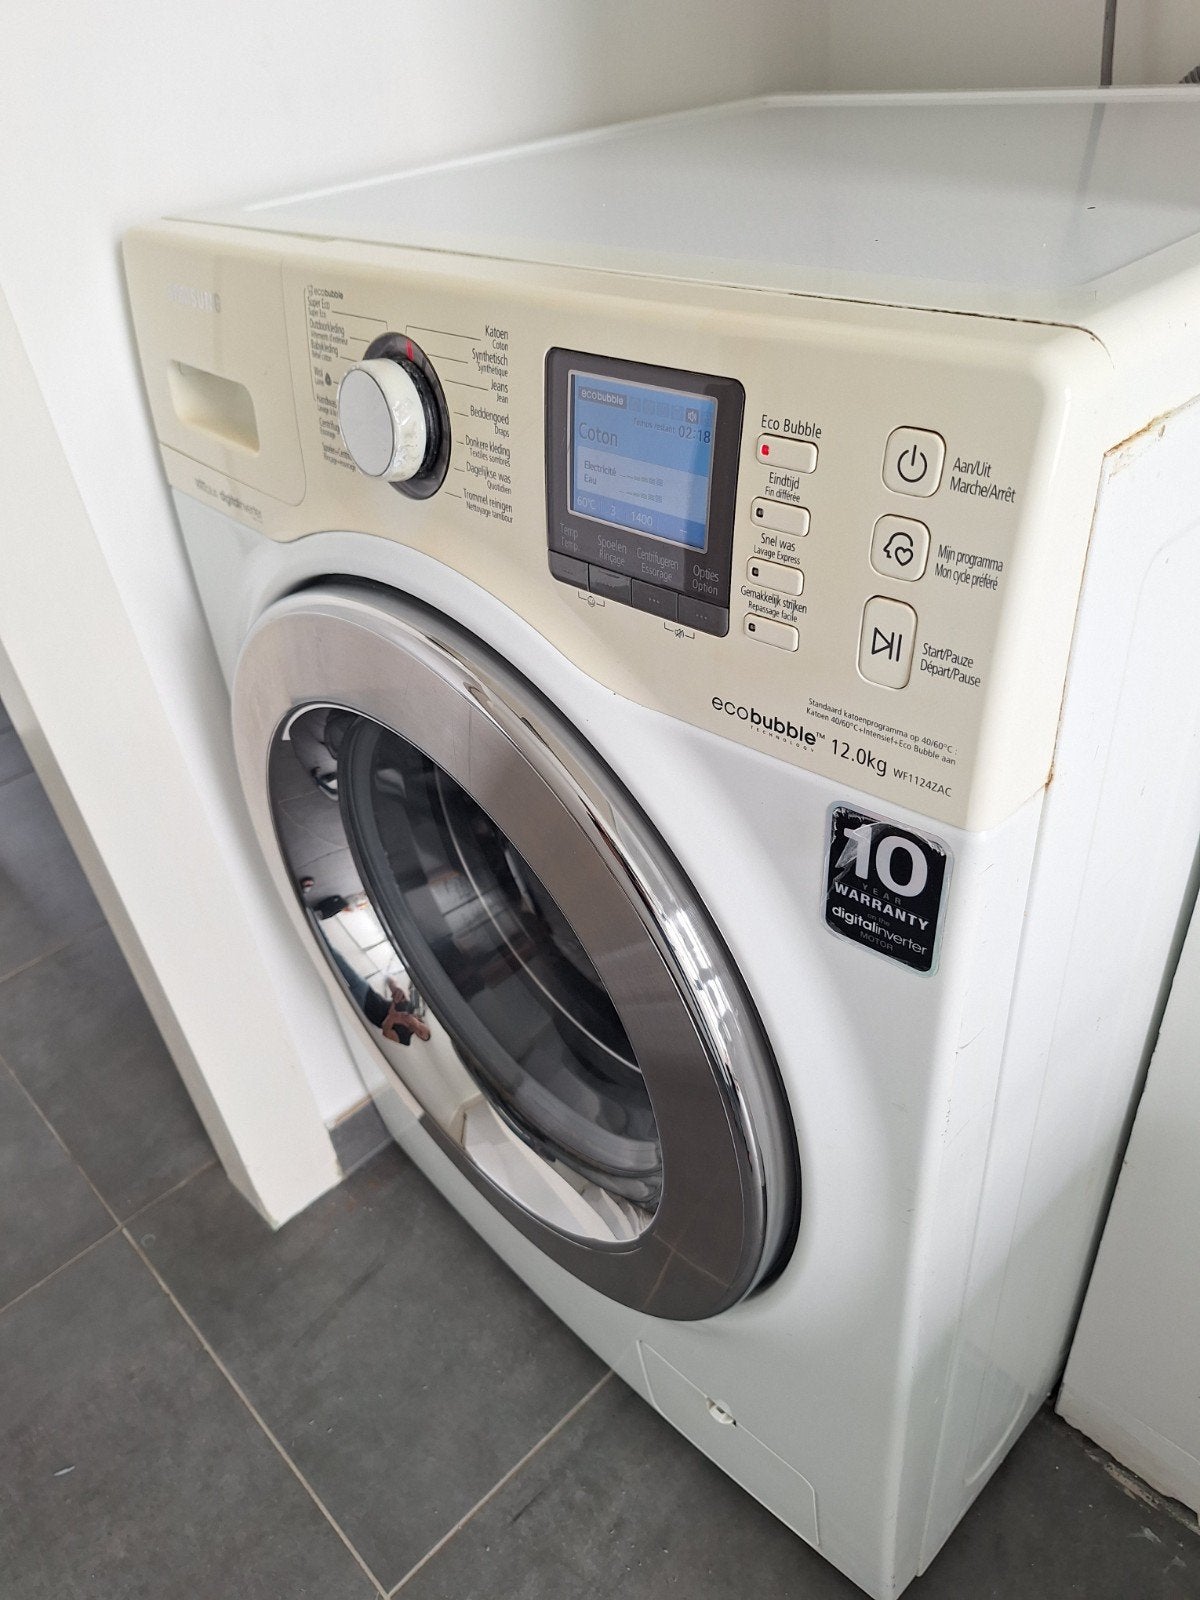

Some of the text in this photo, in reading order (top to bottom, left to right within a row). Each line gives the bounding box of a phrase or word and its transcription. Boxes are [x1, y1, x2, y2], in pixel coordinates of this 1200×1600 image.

[485, 325, 509, 340] Katoen
[492, 339, 508, 351] Coton
[471, 348, 508, 366] Synthetisch
[491, 379, 508, 393] Jeans
[496, 393, 508, 404] Jean
[581, 390, 624, 406] ecobubble
[470, 405, 509, 425] Beddengoed
[761, 414, 822, 439] Eco Bubble
[495, 425, 510, 438] Draps
[579, 422, 618, 447] Coton
[678, 425, 711, 444] 02:18
[465, 434, 511, 459] Donkere kleding
[470, 448, 511, 467] Textiles sombres
[466, 461, 511, 484] Dagelijkse was
[584, 461, 617, 477] Electricité
[952, 457, 992, 478] Aan/Uit
[487, 480, 511, 495] Quotidien
[584, 474, 597, 485] Eau
[769, 472, 800, 491] Eindtijd
[950, 476, 1016, 503] Marche/Arrêt
[463, 488, 513, 514] Trommel reinigen
[765, 486, 800, 503] Fin différée
[466, 501, 513, 524] Nettoyage tambour
[577, 496, 653, 527] 60°C 3 1400
[560, 523, 719, 583] Temp Spoelen Centrifugeren Opties
[761, 533, 796, 552] Snel was
[753, 545, 800, 565] Lavage Express
[938, 544, 1003, 572] Mijn programma
[600, 549, 625, 567] Rinçage
[641, 563, 673, 583] Essorage
[692, 579, 718, 596] Option
[935, 563, 998, 590] Mon cycle préféré
[740, 585, 807, 614] Gemakkelijk strijken
[749, 601, 797, 622] Repassage facile
[922, 643, 974, 669] Start/Pauze
[920, 658, 981, 687] Départ/Pause
[806, 707, 829, 721] Katoen
[913, 744, 940, 760] Bubble
[941, 755, 956, 766] aan
[808, 698, 842, 716] Standaard
[843, 710, 908, 738] katoenprogramma
[910, 733, 920, 743] op
[921, 736, 952, 753] 40/60°C
[750, 725, 814, 753] TECHNOLOGY
[832, 739, 887, 777] 12.0kg
[893, 767, 952, 797] WF1124ZAC
[842, 823, 928, 898] 10
[834, 881, 930, 931] WARRANTY
[862, 883, 902, 906] YEAR
[832, 906, 927, 955] digitalinverter
[860, 931, 893, 951] MOTOR
